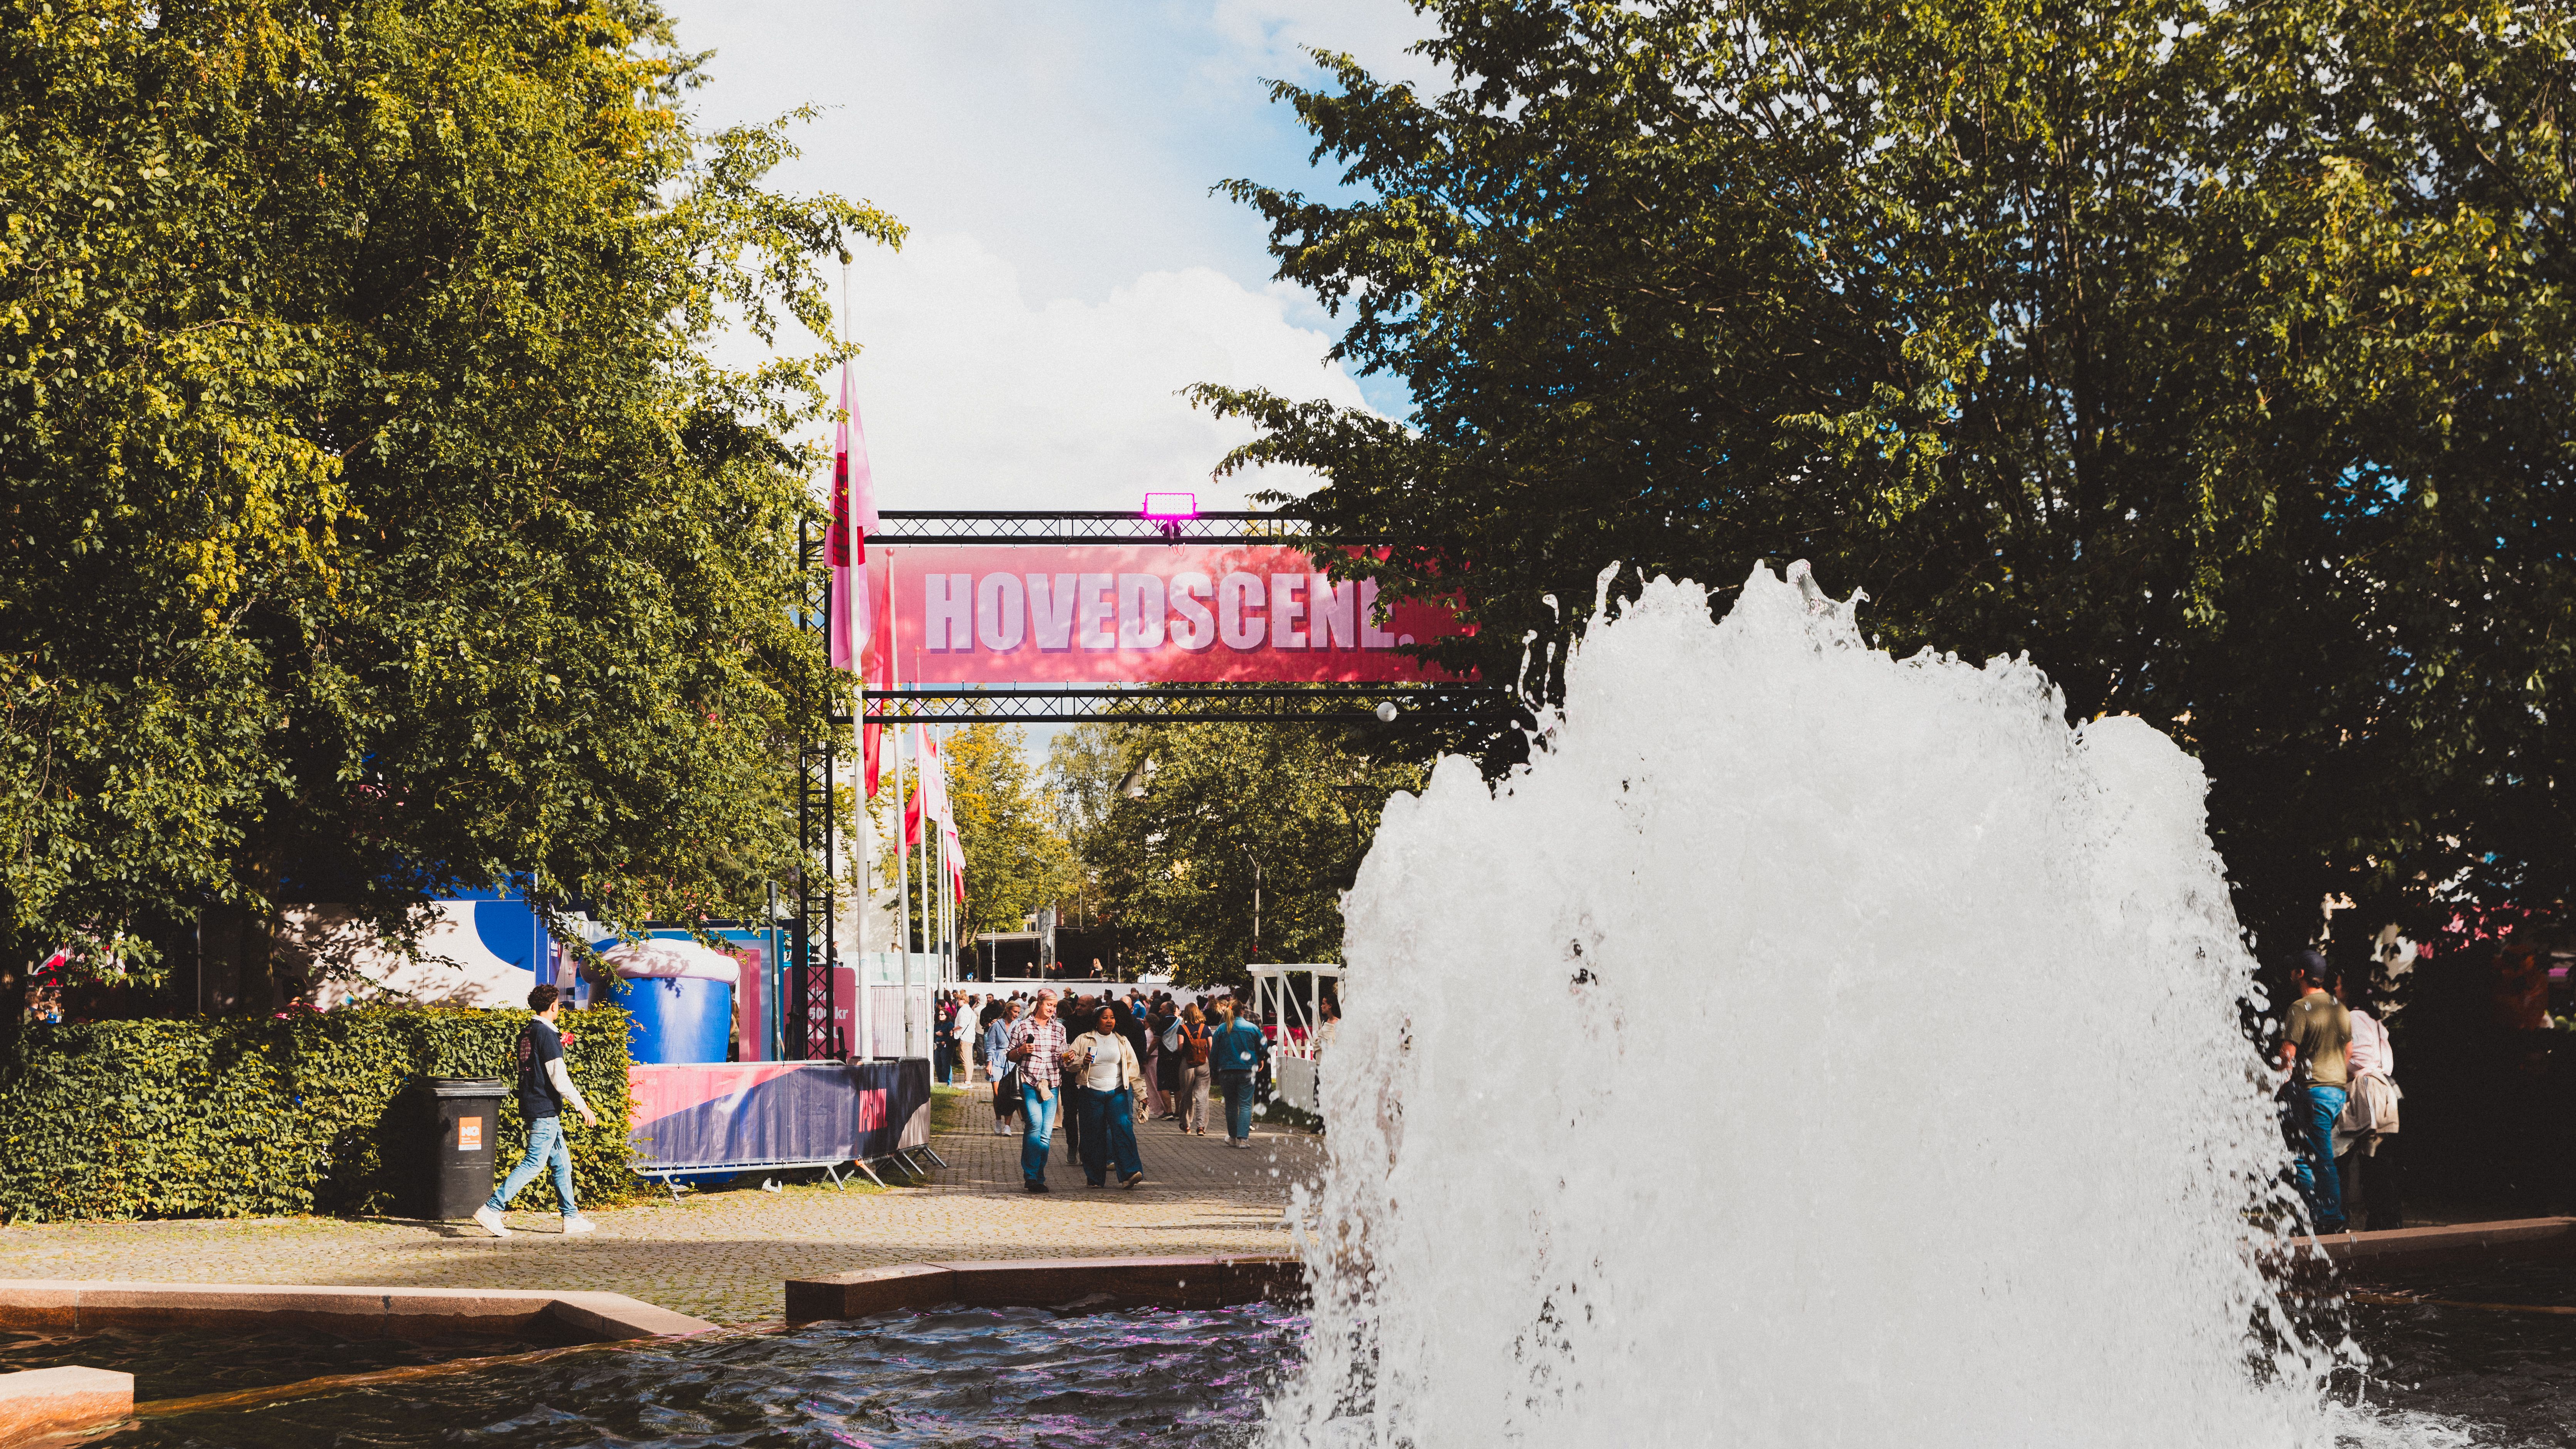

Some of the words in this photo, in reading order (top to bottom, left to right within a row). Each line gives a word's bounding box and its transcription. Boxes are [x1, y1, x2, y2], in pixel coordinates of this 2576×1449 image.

[808, 986, 835, 1000] Vin
[835, 1006, 848, 1019] kr
[461, 1126, 480, 1137] NG
